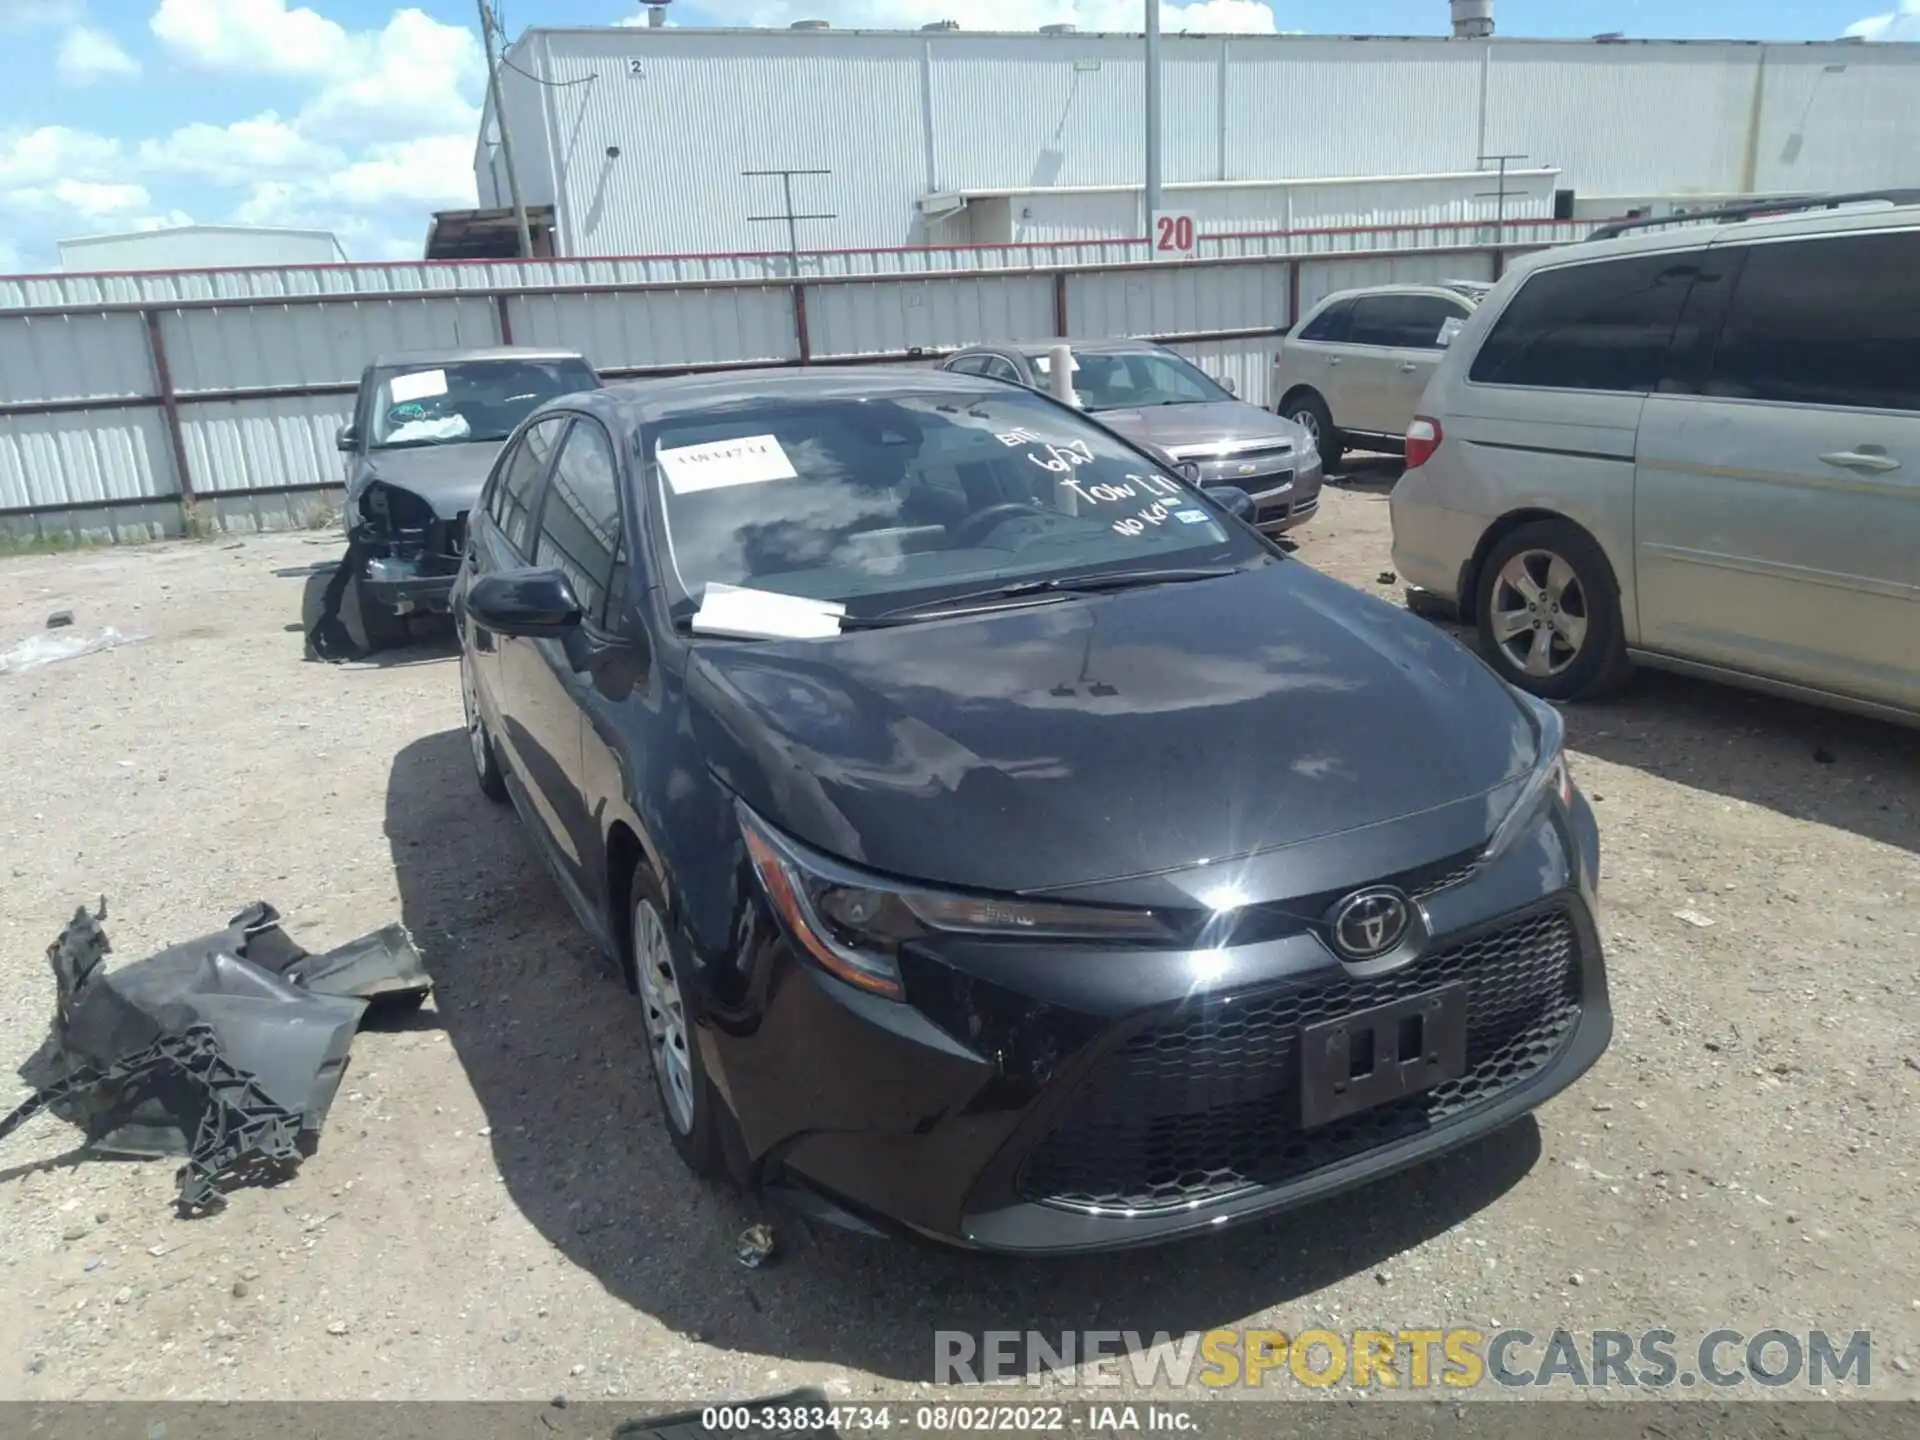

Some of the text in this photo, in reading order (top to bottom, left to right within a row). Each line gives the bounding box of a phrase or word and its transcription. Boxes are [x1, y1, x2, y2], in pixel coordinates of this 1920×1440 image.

[631, 60, 642, 73] 2
[1157, 215, 1193, 251] 20
[1027, 438, 1095, 472] 6/27
